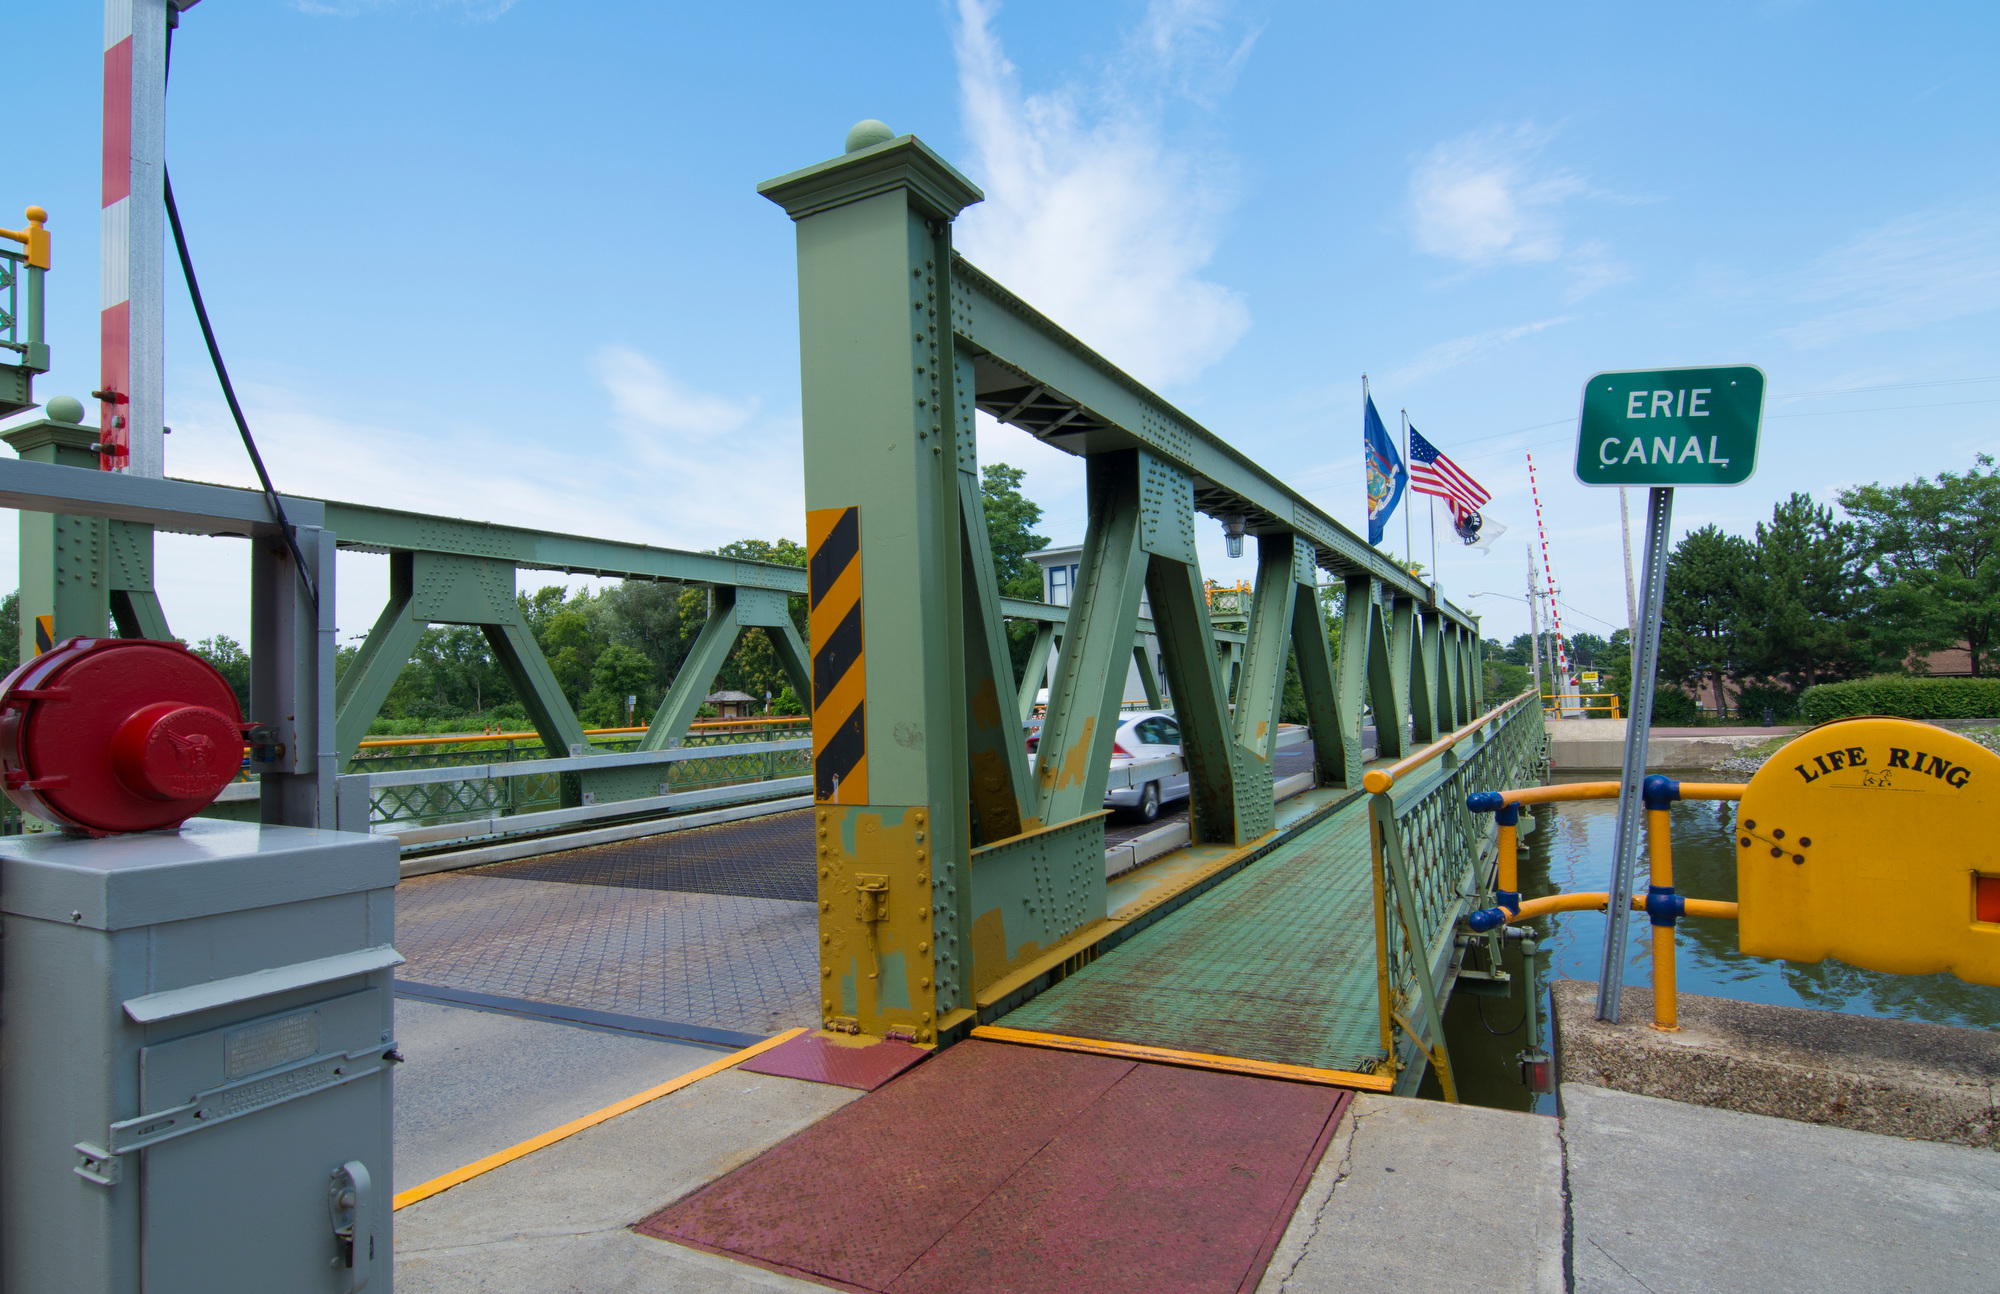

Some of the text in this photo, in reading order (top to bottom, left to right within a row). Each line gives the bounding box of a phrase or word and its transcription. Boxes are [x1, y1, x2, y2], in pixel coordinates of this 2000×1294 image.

[1627, 388, 1711, 418] ERIE
[1600, 435, 1730, 465] CANAL
[1795, 747, 1971, 789] LIFE RING
